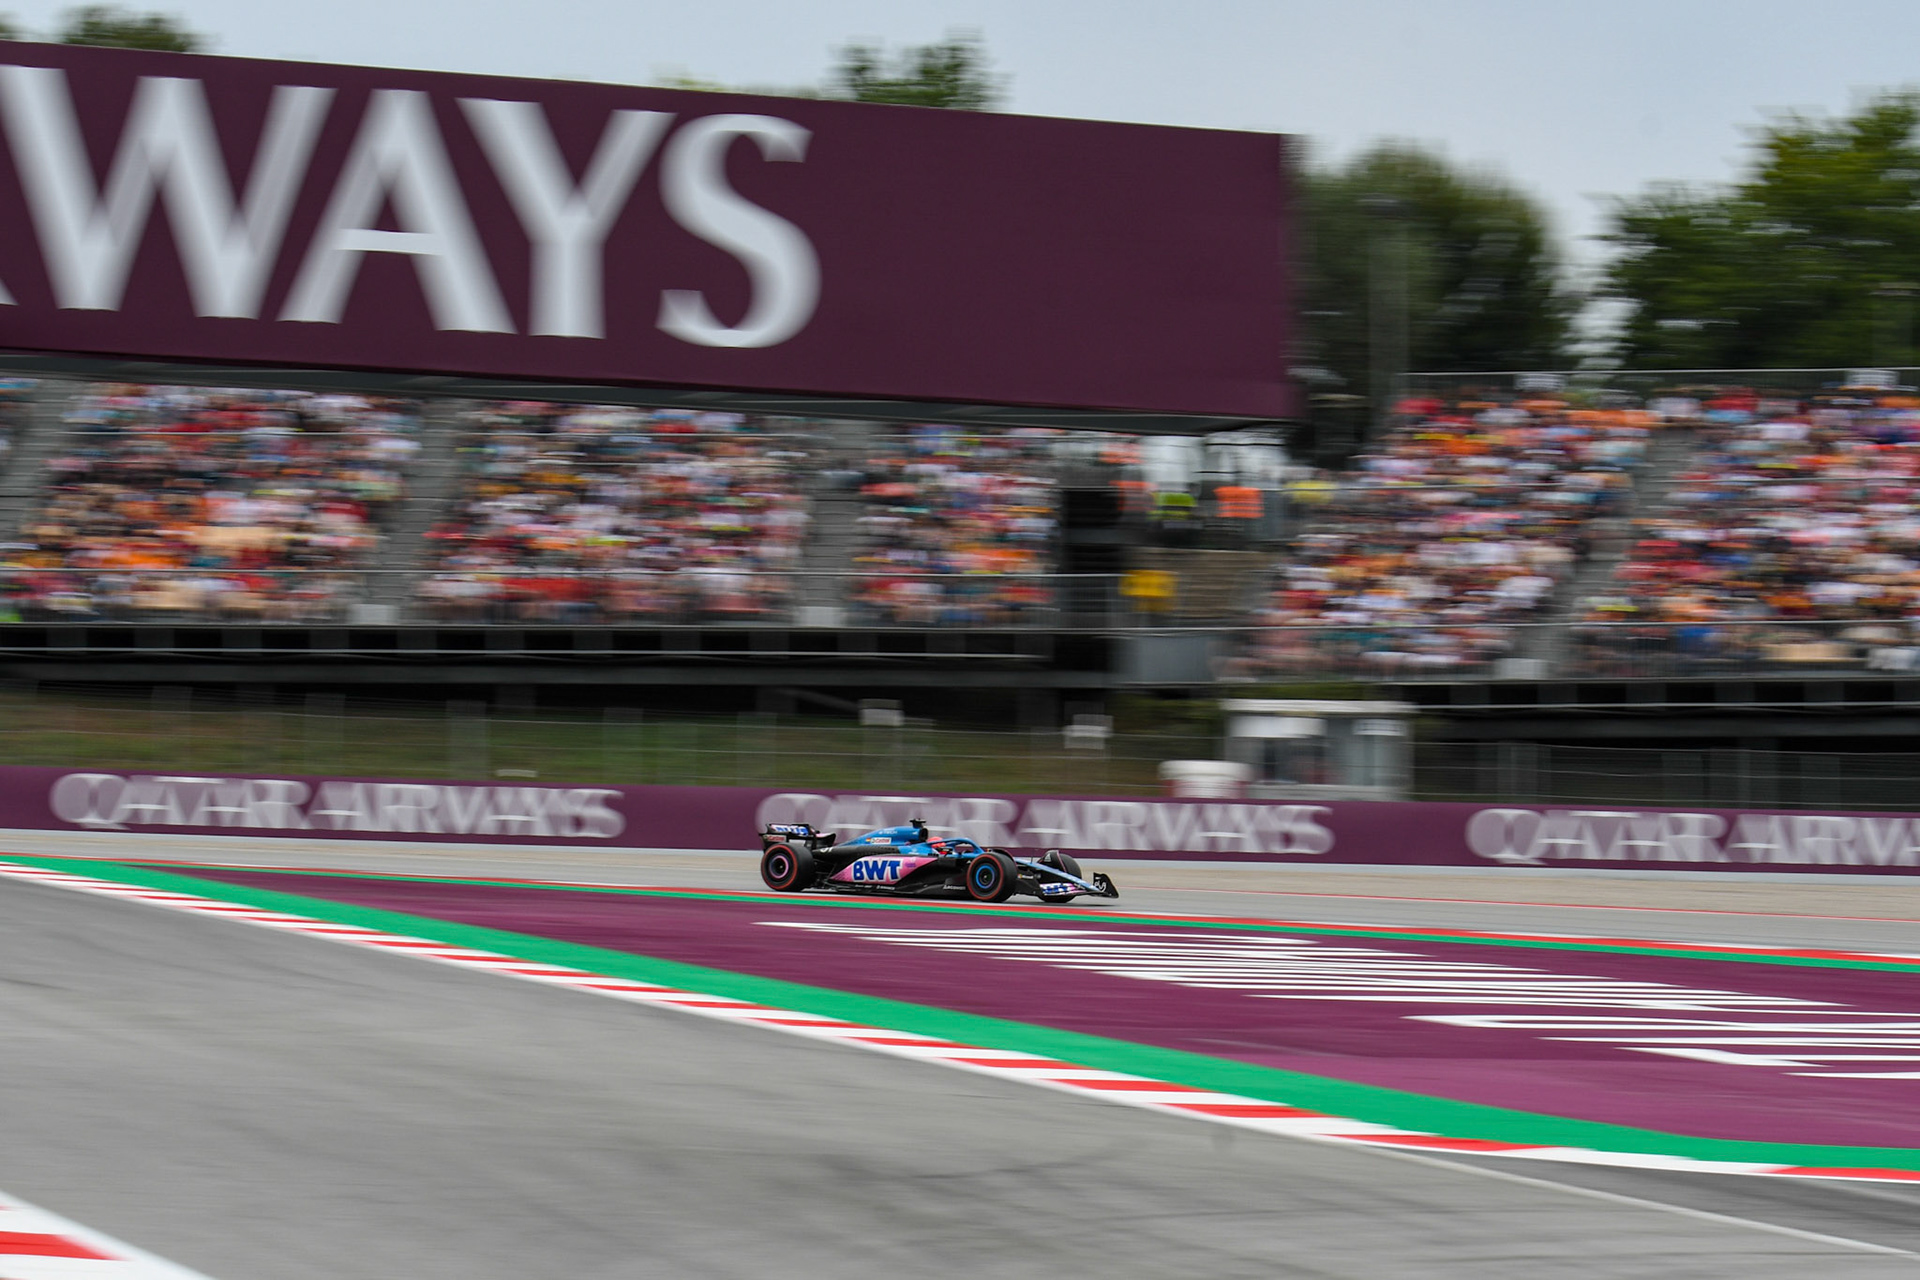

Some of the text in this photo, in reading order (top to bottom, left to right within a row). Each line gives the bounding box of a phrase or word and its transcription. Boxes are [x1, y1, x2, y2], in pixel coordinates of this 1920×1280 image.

[0, 63, 823, 348] WAYS
[50, 772, 627, 839] QATAR AIRWAYS
[1019, 799, 1335, 855] AIRWAYS
[1465, 808, 1920, 867] QATAR AIRW
[852, 859, 902, 882] BWT
